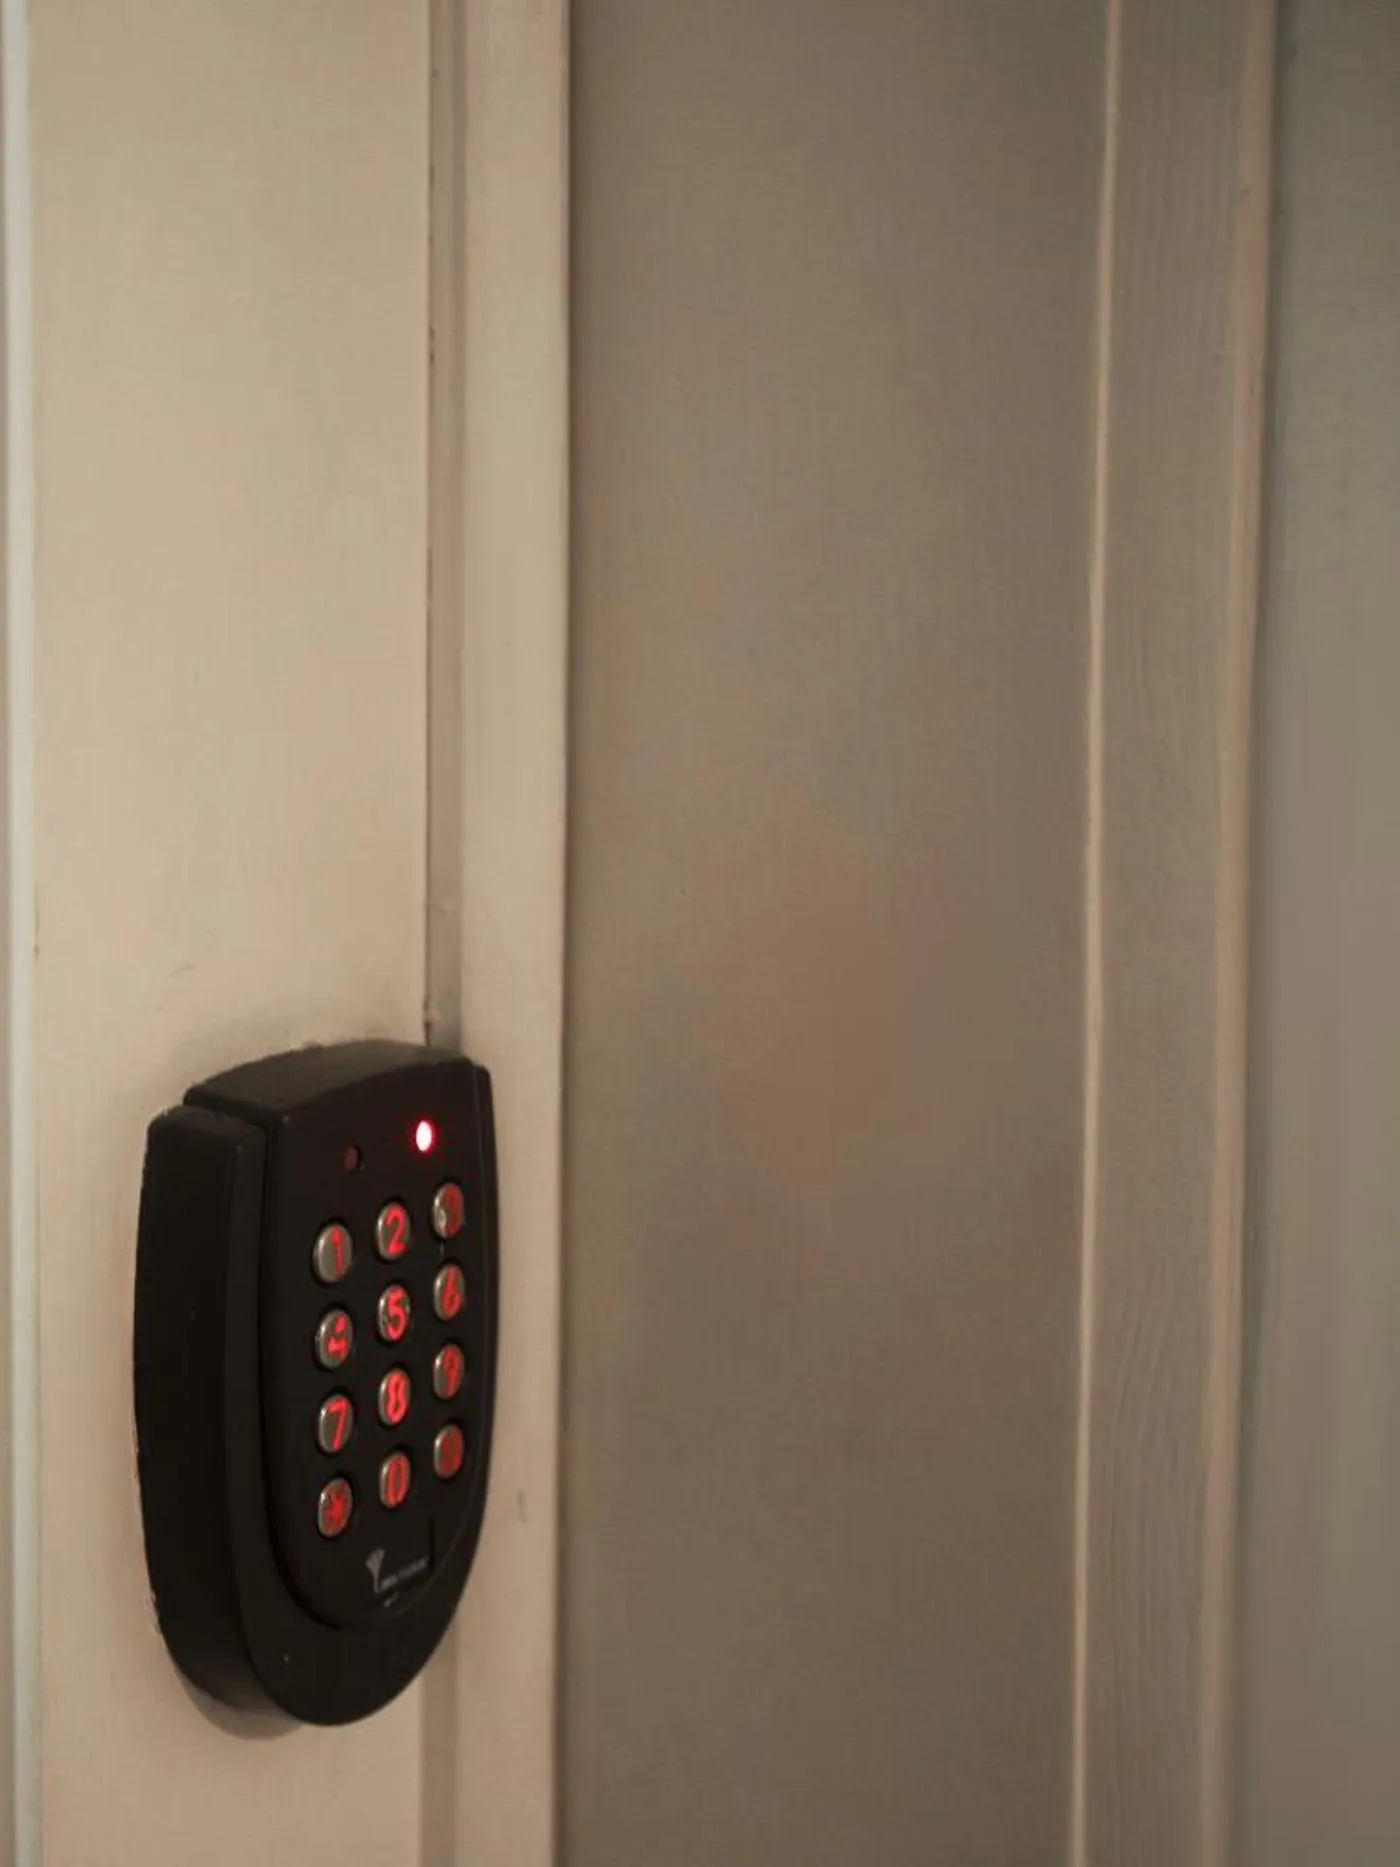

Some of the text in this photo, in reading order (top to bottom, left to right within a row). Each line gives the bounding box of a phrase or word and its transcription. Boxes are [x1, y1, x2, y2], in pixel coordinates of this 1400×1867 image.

[385, 1206, 406, 1256] 2
[386, 1288, 408, 1341] 5
[328, 1397, 350, 1450] 7
[386, 1371, 408, 1424] 8
[386, 1454, 408, 1505] 0
